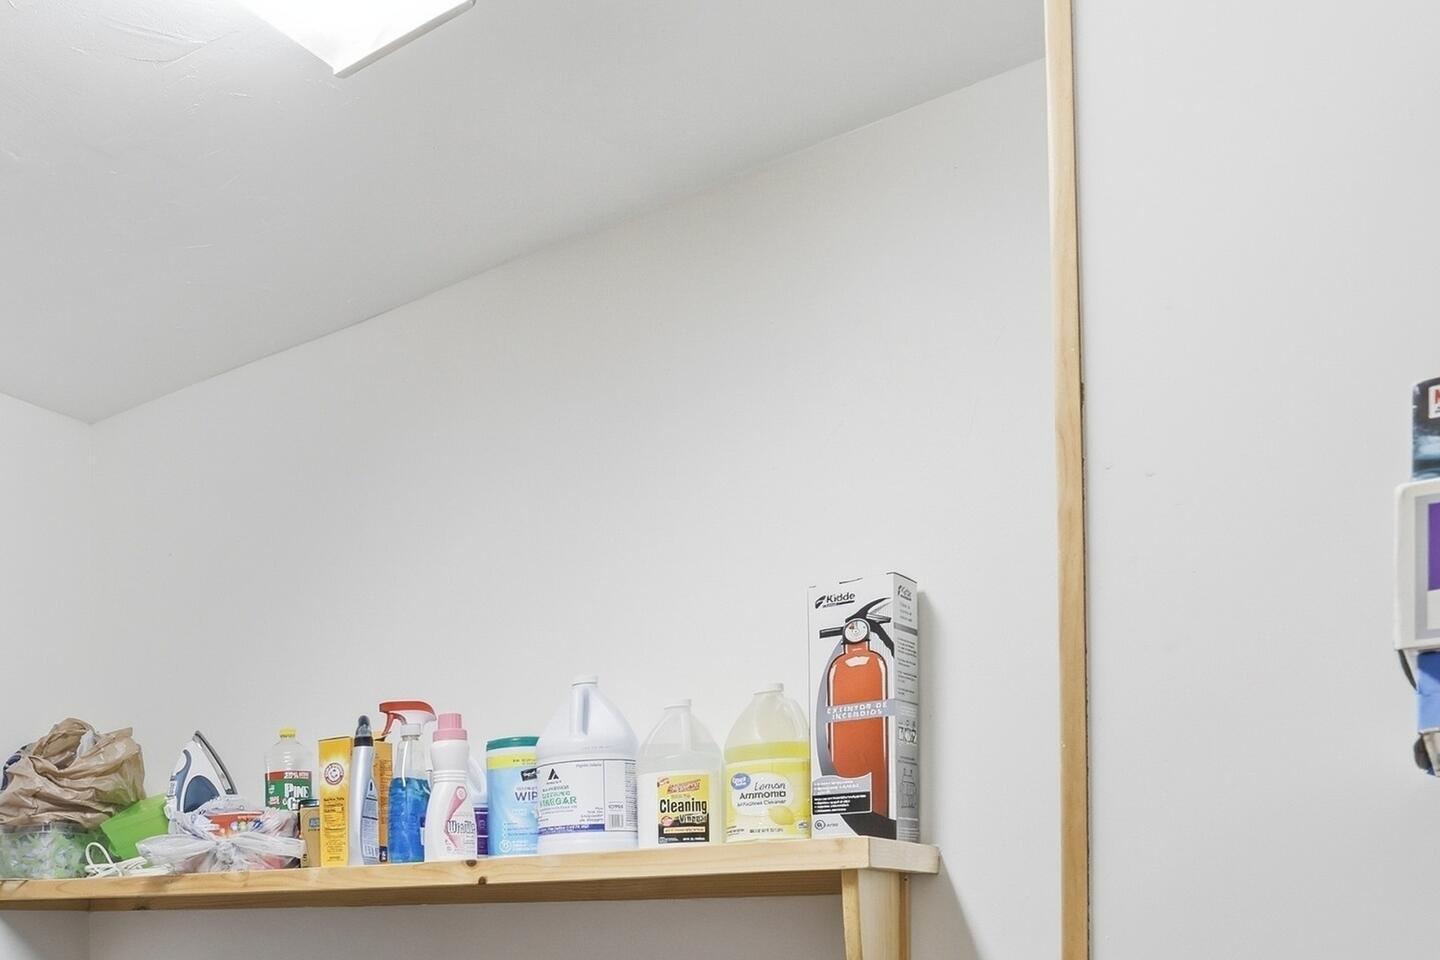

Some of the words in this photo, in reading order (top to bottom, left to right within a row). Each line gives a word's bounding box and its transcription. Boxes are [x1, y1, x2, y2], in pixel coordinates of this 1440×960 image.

[827, 592, 856, 604] Kidde
[832, 709, 882, 720] INCENDIOS
[659, 797, 707, 814] Cleaning
